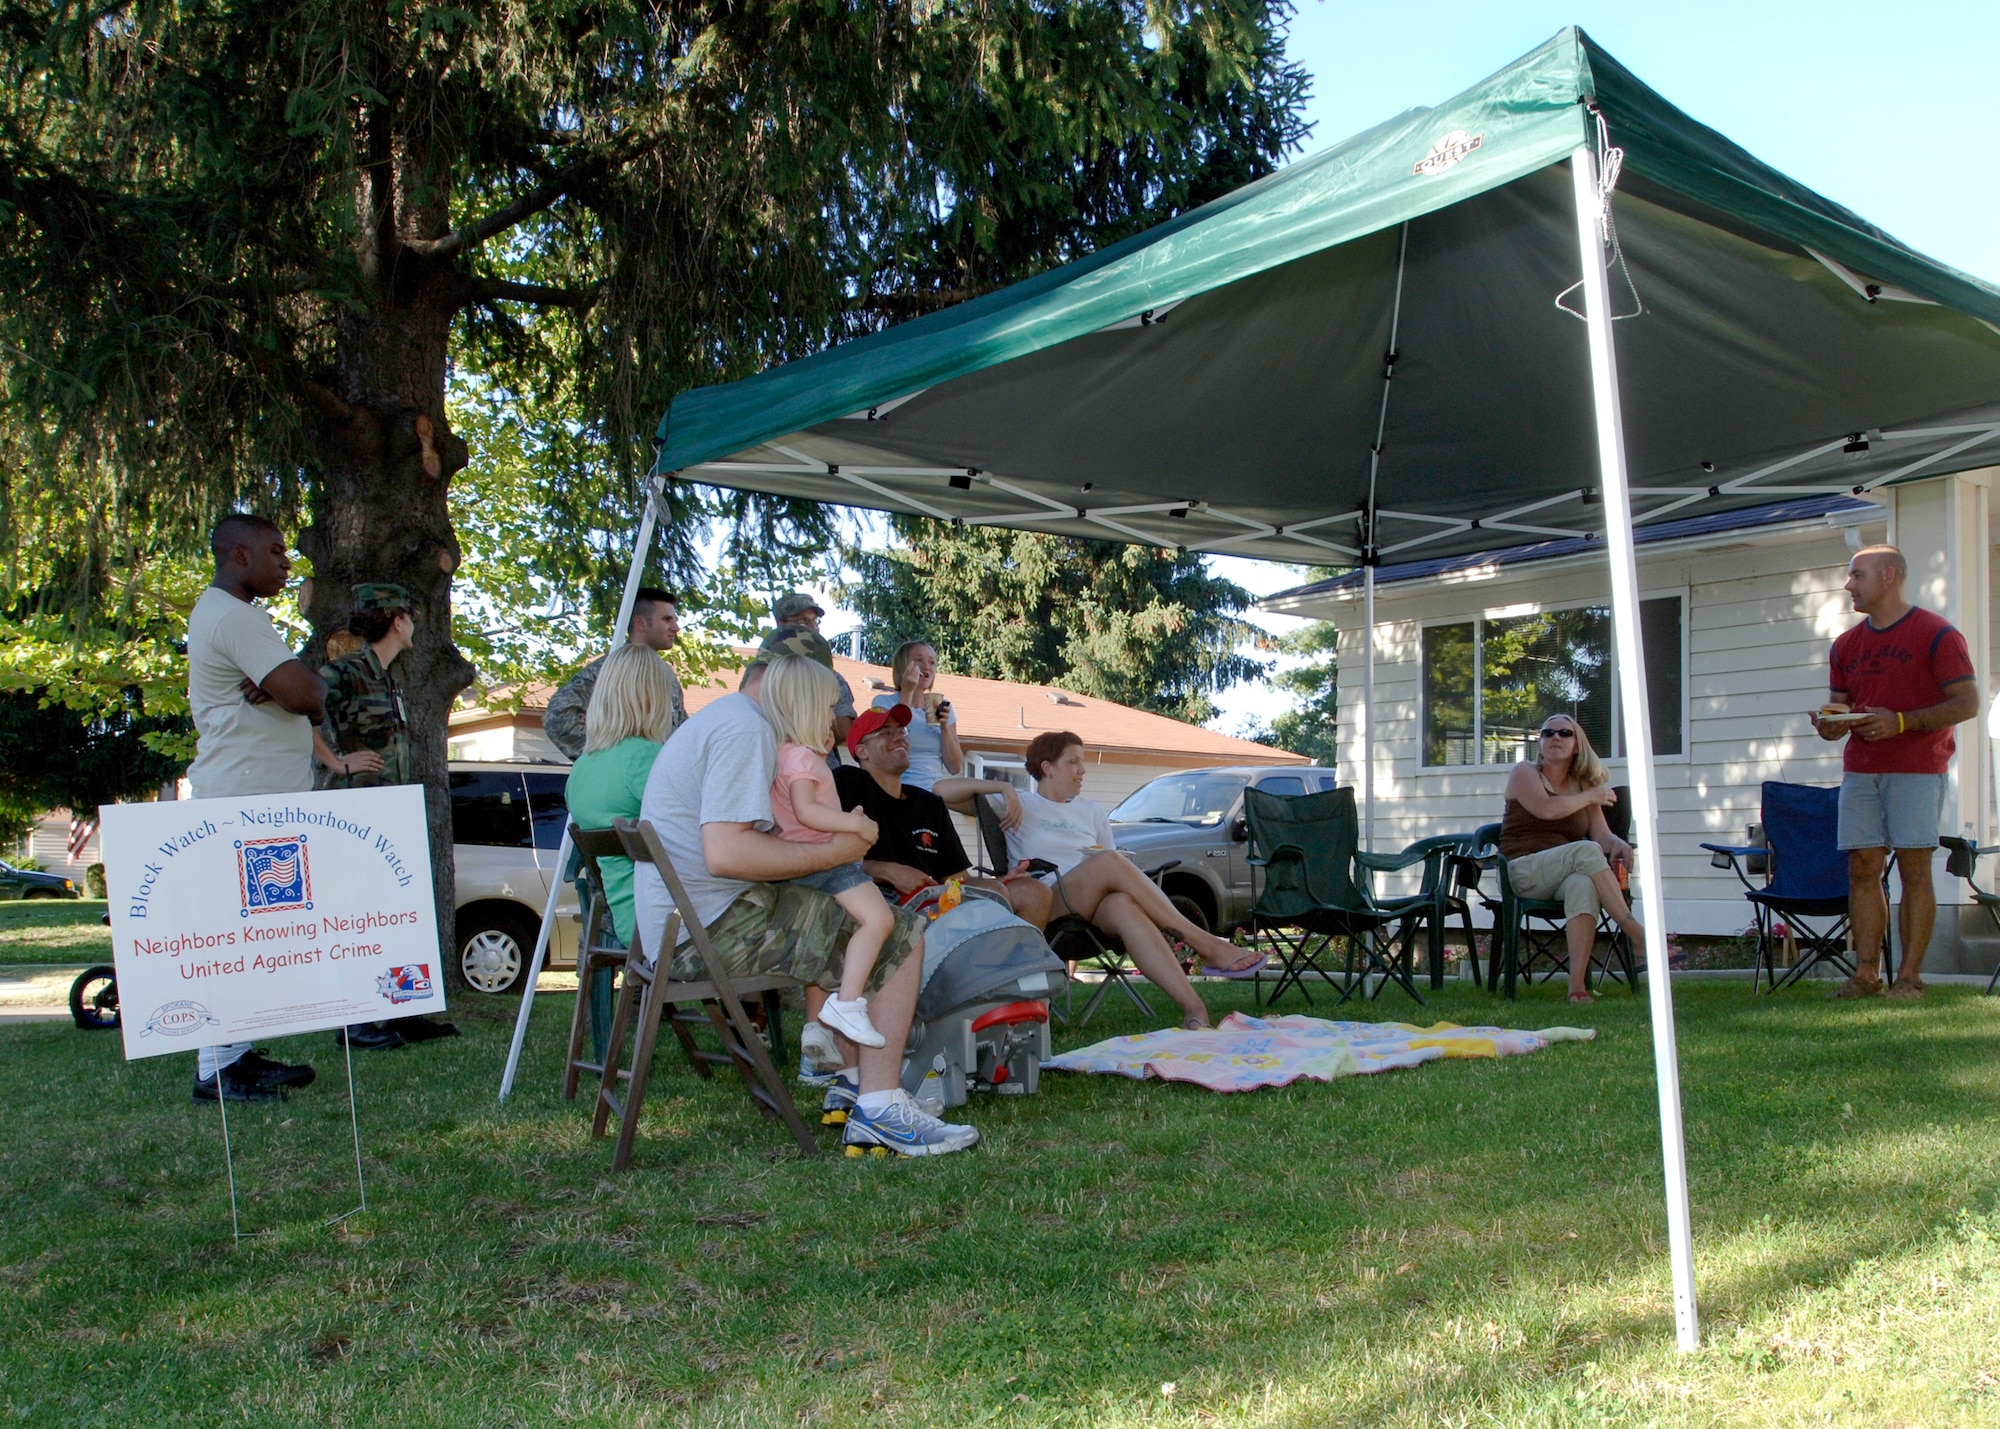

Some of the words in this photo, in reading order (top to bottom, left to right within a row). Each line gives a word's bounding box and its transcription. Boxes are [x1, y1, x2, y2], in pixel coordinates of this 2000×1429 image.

[1420, 140, 1475, 170] QUEST
[129, 861, 164, 919] Block
[158, 820, 218, 858] Watch
[239, 807, 371, 840] Neighborhood
[374, 834, 413, 888] Watch
[134, 931, 236, 957] Neighbors
[243, 921, 317, 943] Knowing
[323, 911, 417, 934] Neighbors
[180, 955, 245, 980] United
[252, 948, 322, 973] Against
[329, 942, 383, 960] Crime
